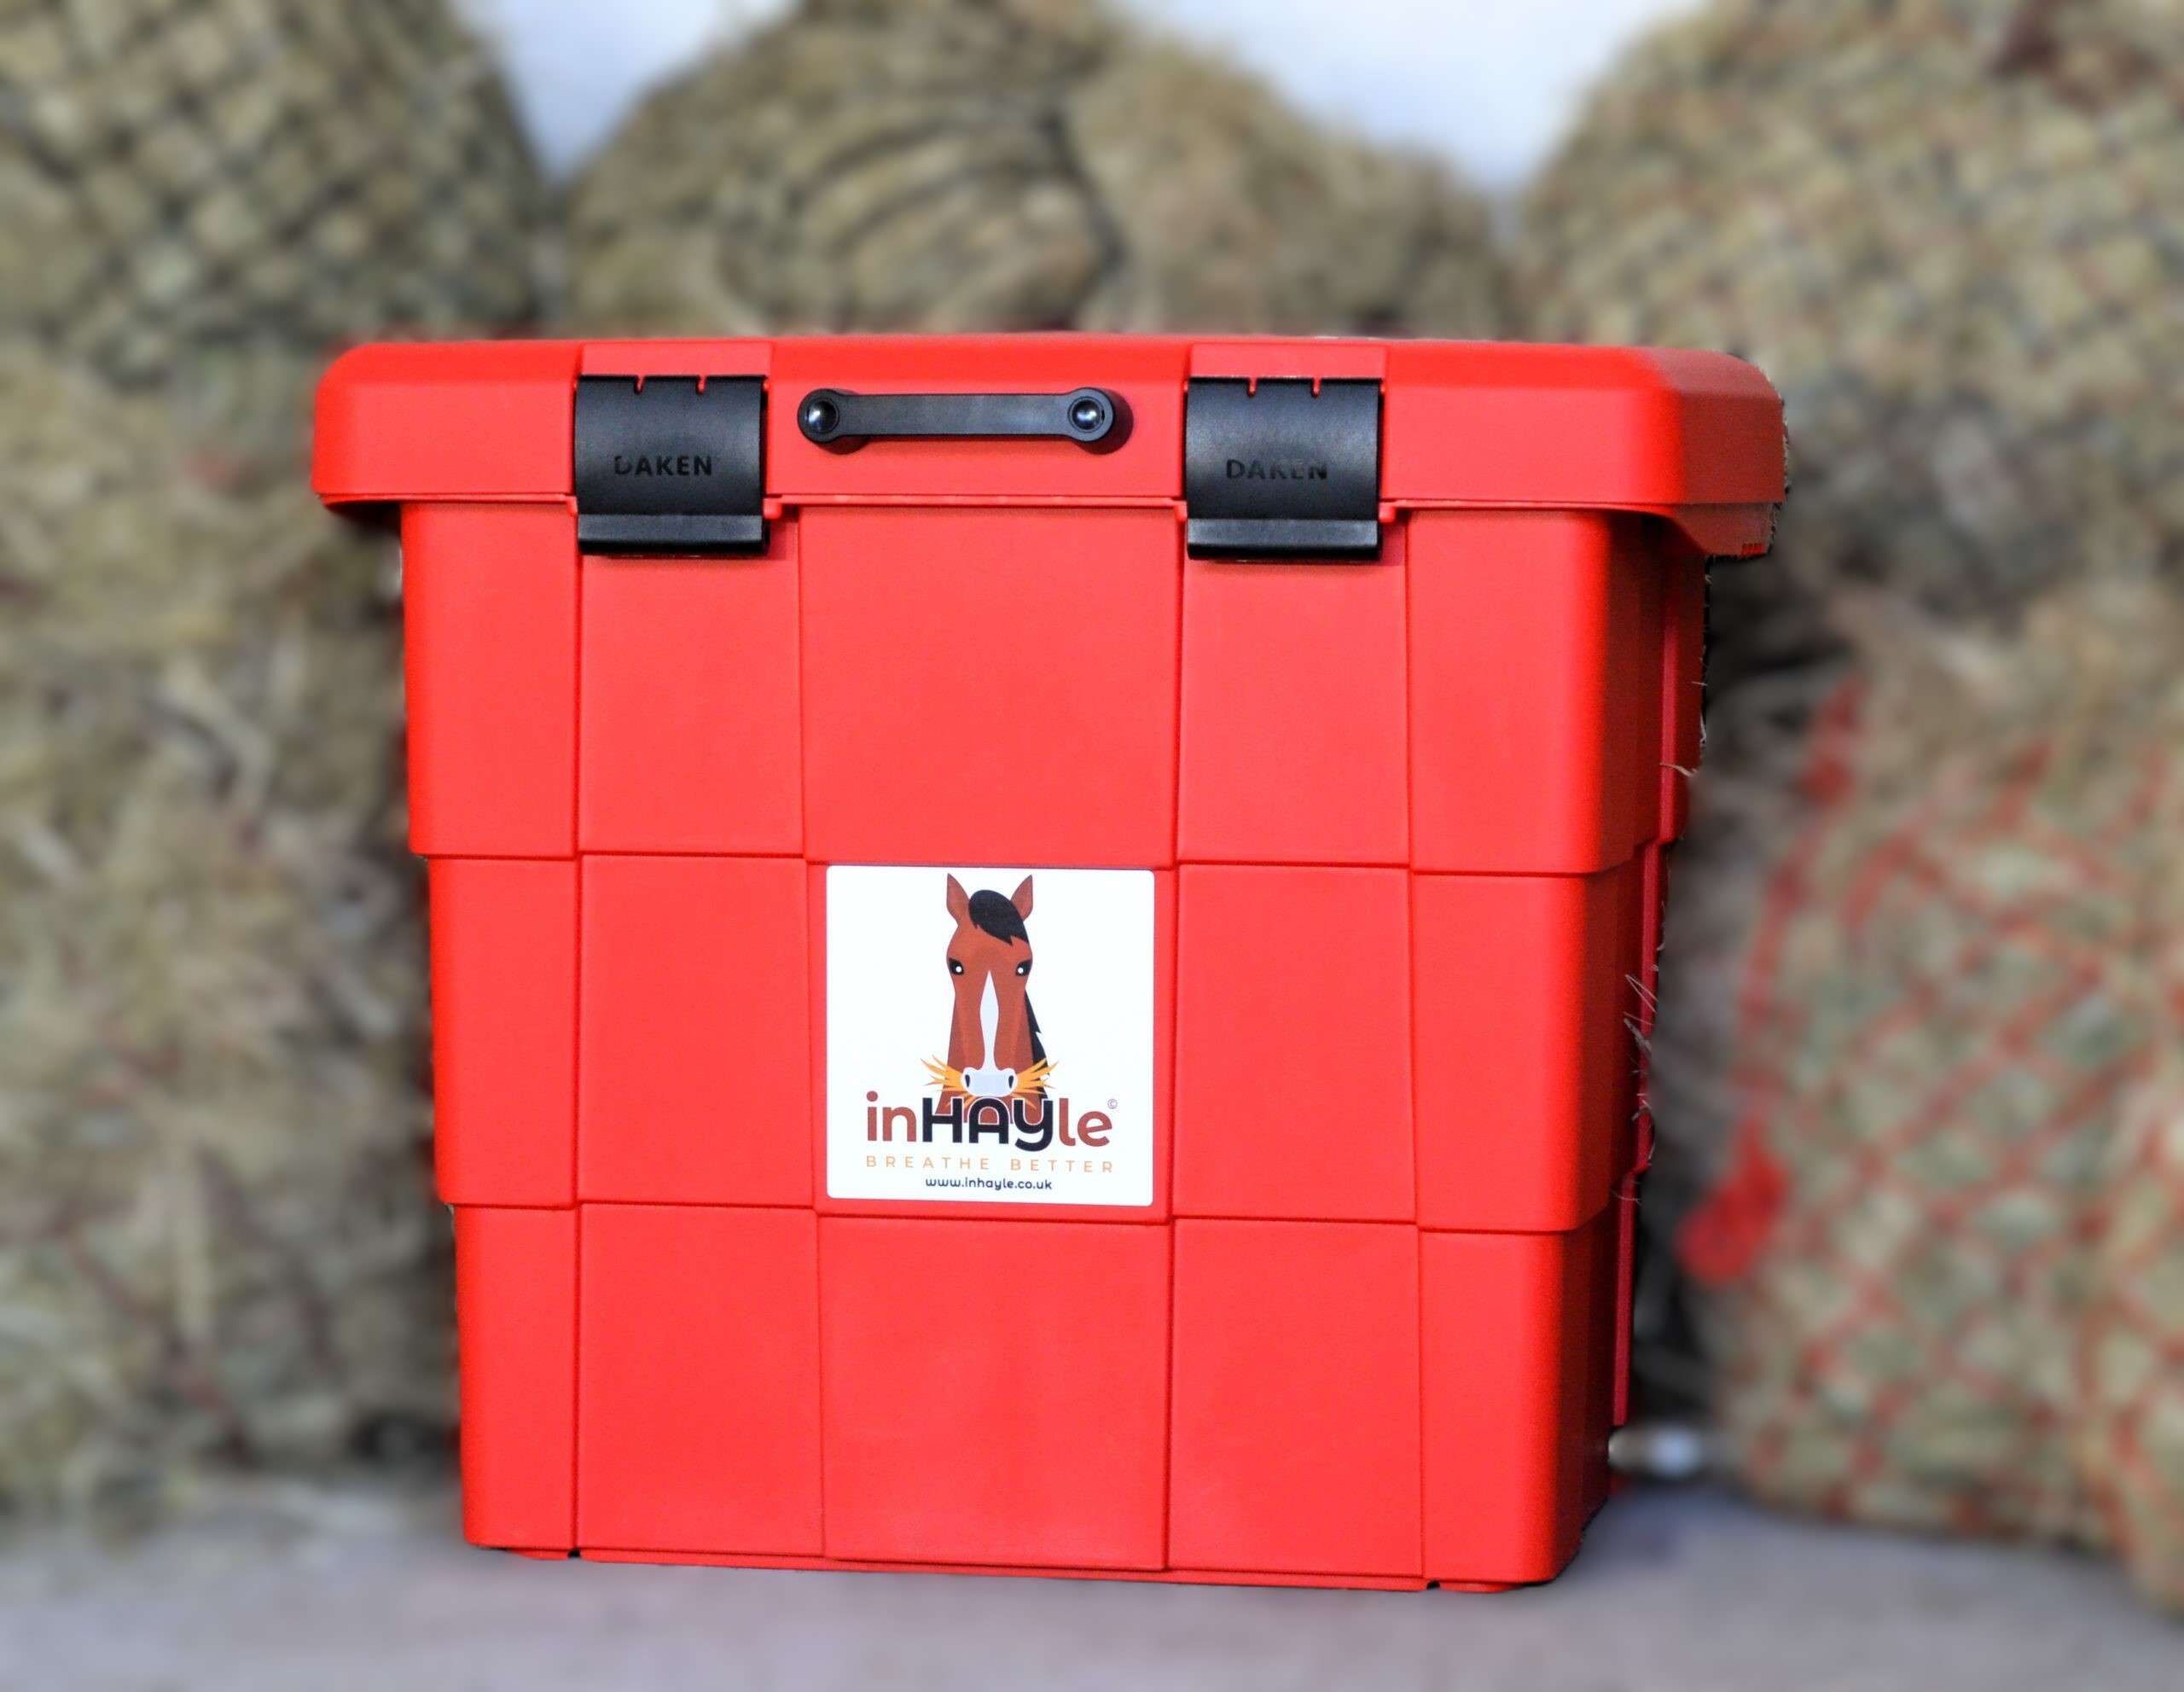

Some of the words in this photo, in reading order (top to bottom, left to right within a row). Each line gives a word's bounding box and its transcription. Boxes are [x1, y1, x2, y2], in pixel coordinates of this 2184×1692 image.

[614, 456, 712, 476] DAKEN
[1226, 459, 1327, 480] DAKEN
[866, 1155, 990, 1170] BREATHE
[1010, 1158, 1113, 1173] BETTER
[925, 1177, 1053, 1190] www.inhayle.co.uk
